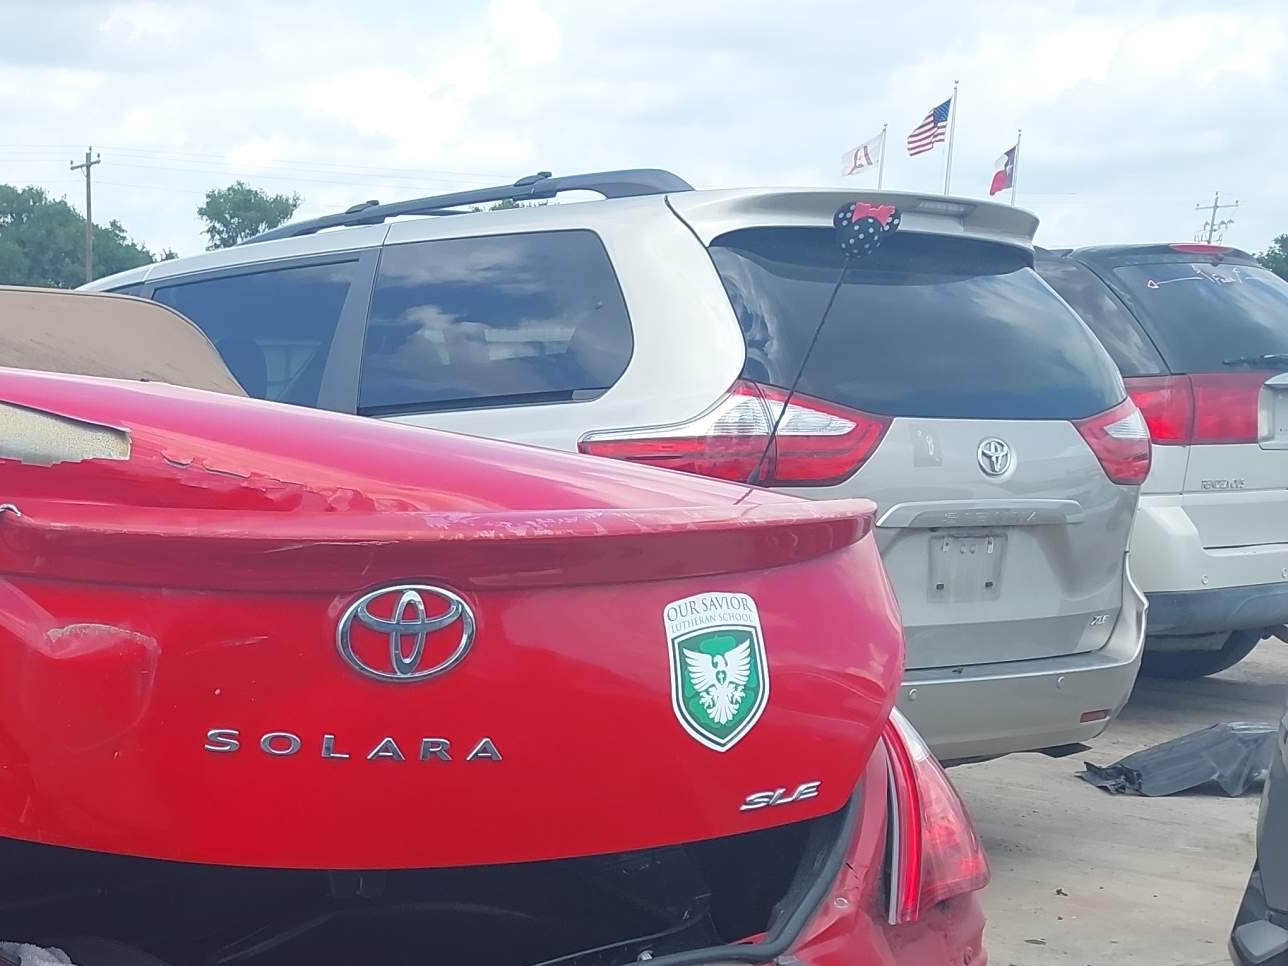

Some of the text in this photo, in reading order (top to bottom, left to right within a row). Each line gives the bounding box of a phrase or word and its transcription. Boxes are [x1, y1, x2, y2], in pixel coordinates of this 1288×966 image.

[667, 596, 753, 622] OUR SAVIOR
[671, 612, 752, 633] LUTHERAN SCHOOL
[204, 729, 503, 761] SOLARA
[739, 780, 821, 811] SLE
